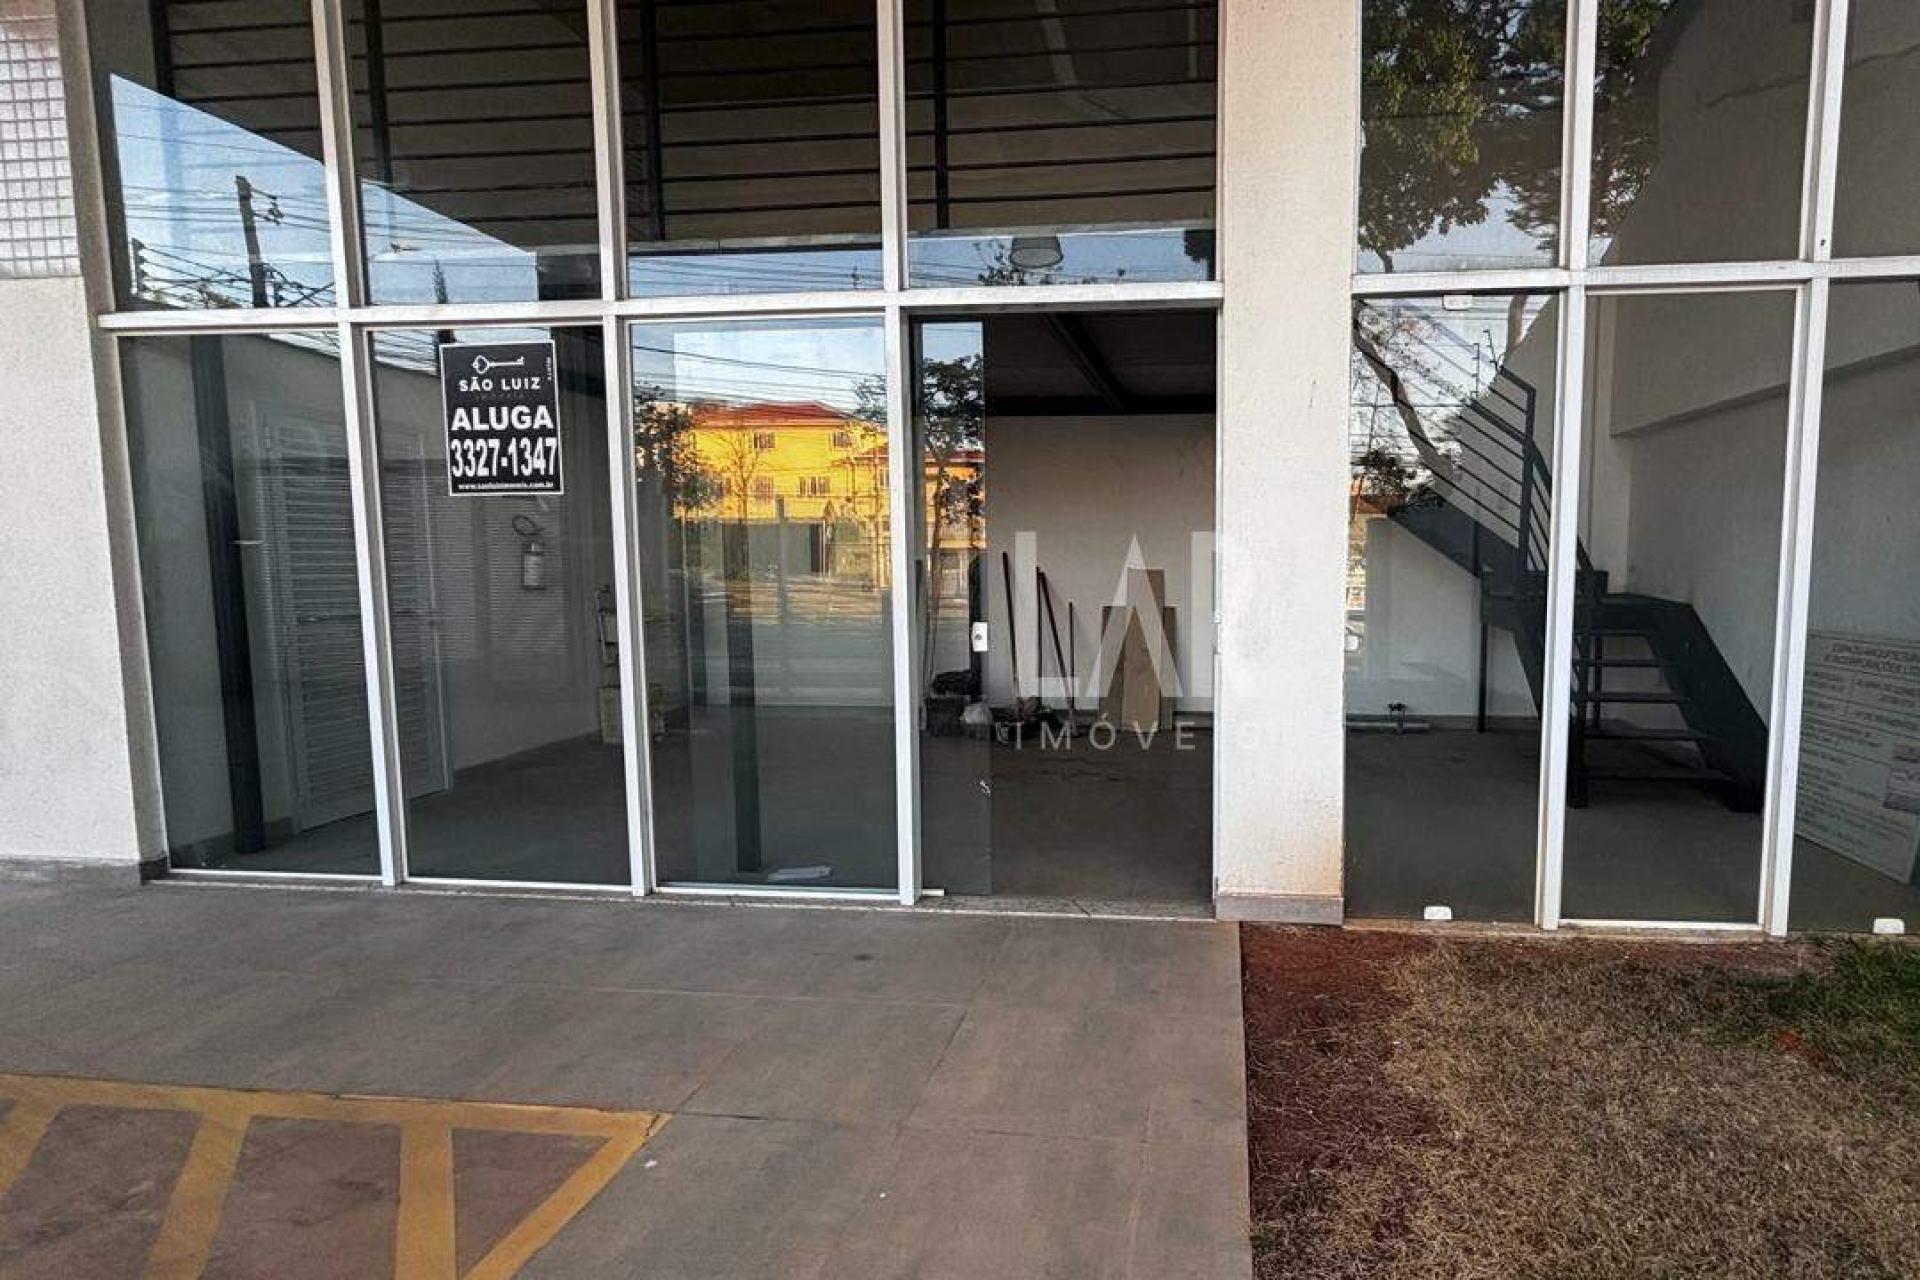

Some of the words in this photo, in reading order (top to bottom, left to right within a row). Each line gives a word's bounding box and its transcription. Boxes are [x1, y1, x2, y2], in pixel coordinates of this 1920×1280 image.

[459, 376, 493, 391] SÃO
[501, 376, 541, 390] LUIZ
[451, 405, 554, 431] ALUGA
[451, 437, 557, 477] 3327-1347
